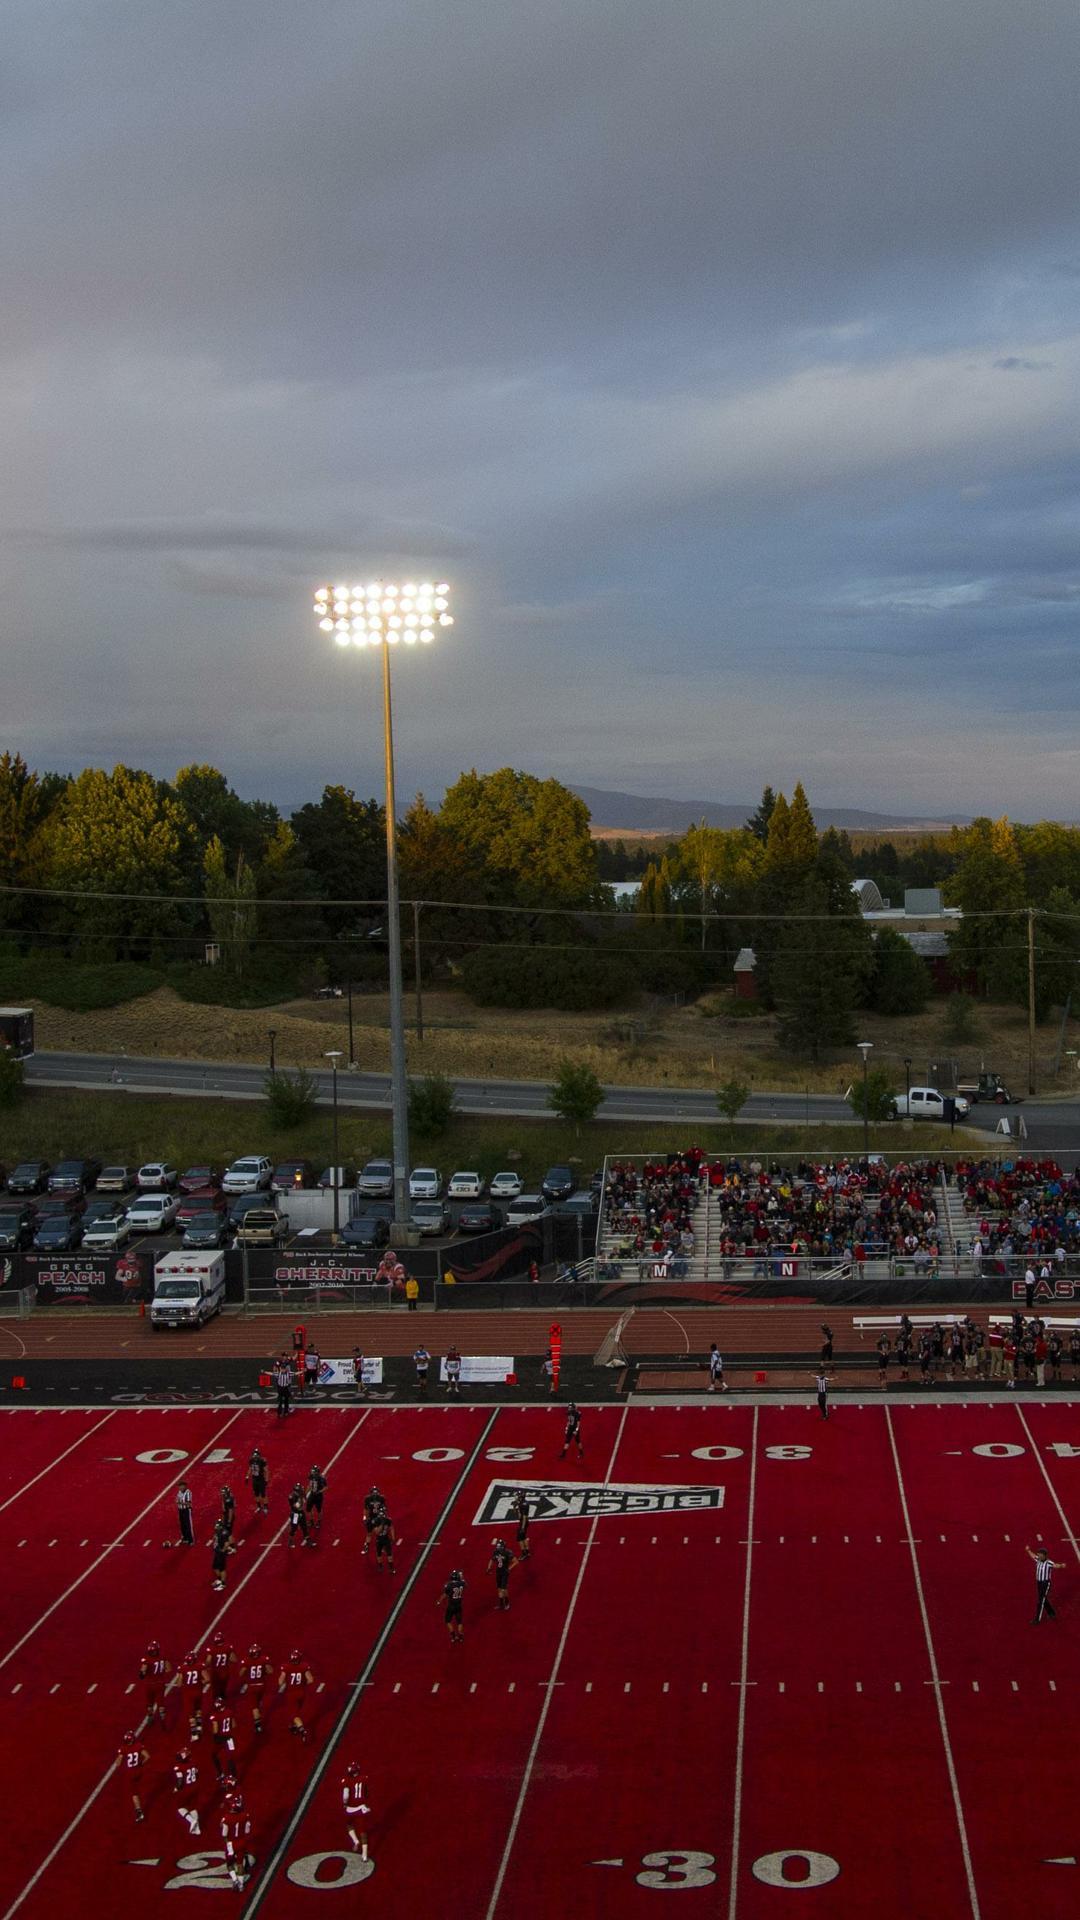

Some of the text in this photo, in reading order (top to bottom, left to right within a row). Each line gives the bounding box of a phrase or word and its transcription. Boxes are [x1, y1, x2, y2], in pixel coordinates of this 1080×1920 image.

[276, 1268, 377, 1281] SHERRITT
[654, 1264, 667, 1277] M
[781, 1263, 793, 1276] N
[38, 1271, 105, 1285] PEACH
[216, 1653, 227, 1667] 73
[186, 1670, 198, 1685] 72
[250, 1665, 262, 1679] 66
[290, 1672, 302, 1685] 79
[127, 1752, 139, 1768] 23
[354, 1782, 363, 1799] 11
[635, 1850, 841, 1888] 30
